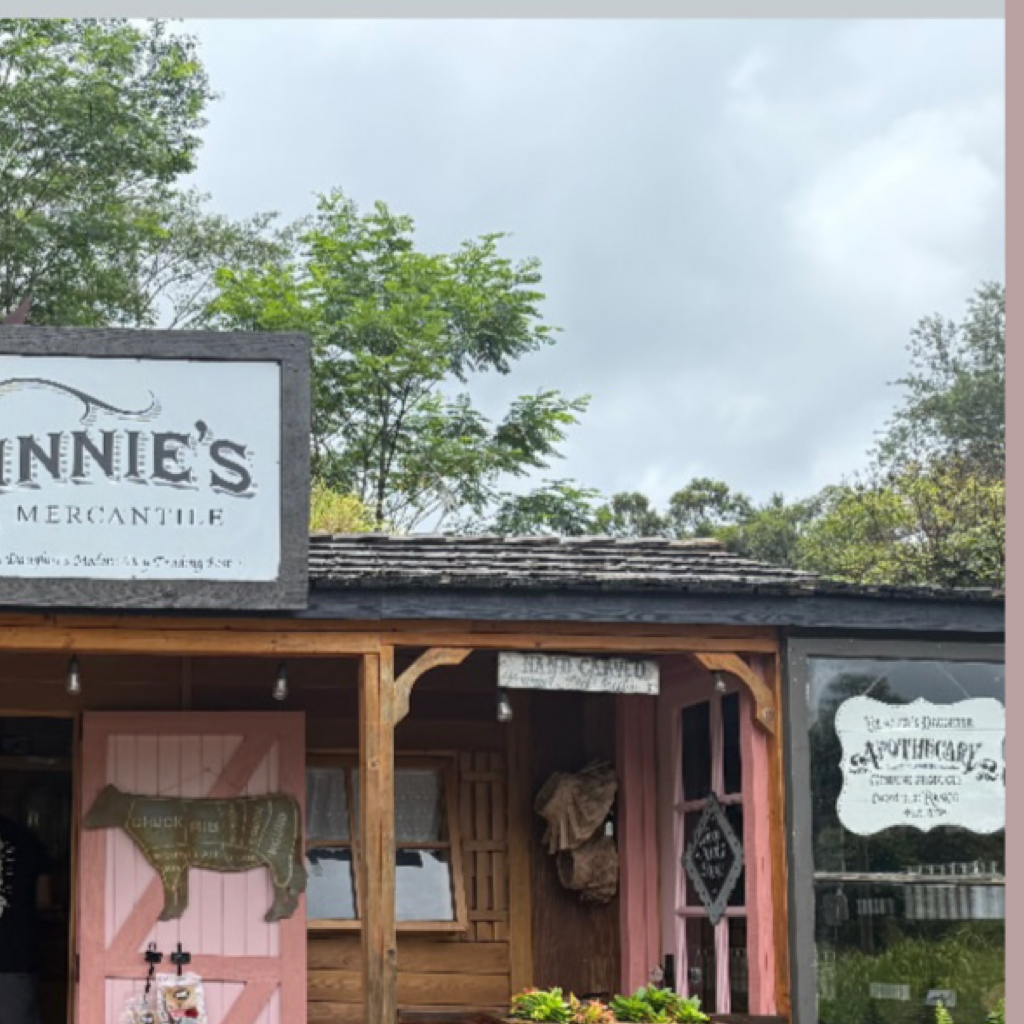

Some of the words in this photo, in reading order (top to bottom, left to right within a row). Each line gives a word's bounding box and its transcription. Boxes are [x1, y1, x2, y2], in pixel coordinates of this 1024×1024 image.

[16, 504, 224, 526] MERCANTILE
[864, 737, 983, 775] APOTHECARY
[132, 814, 183, 828] CHUCK
[189, 819, 220, 833] RIB
